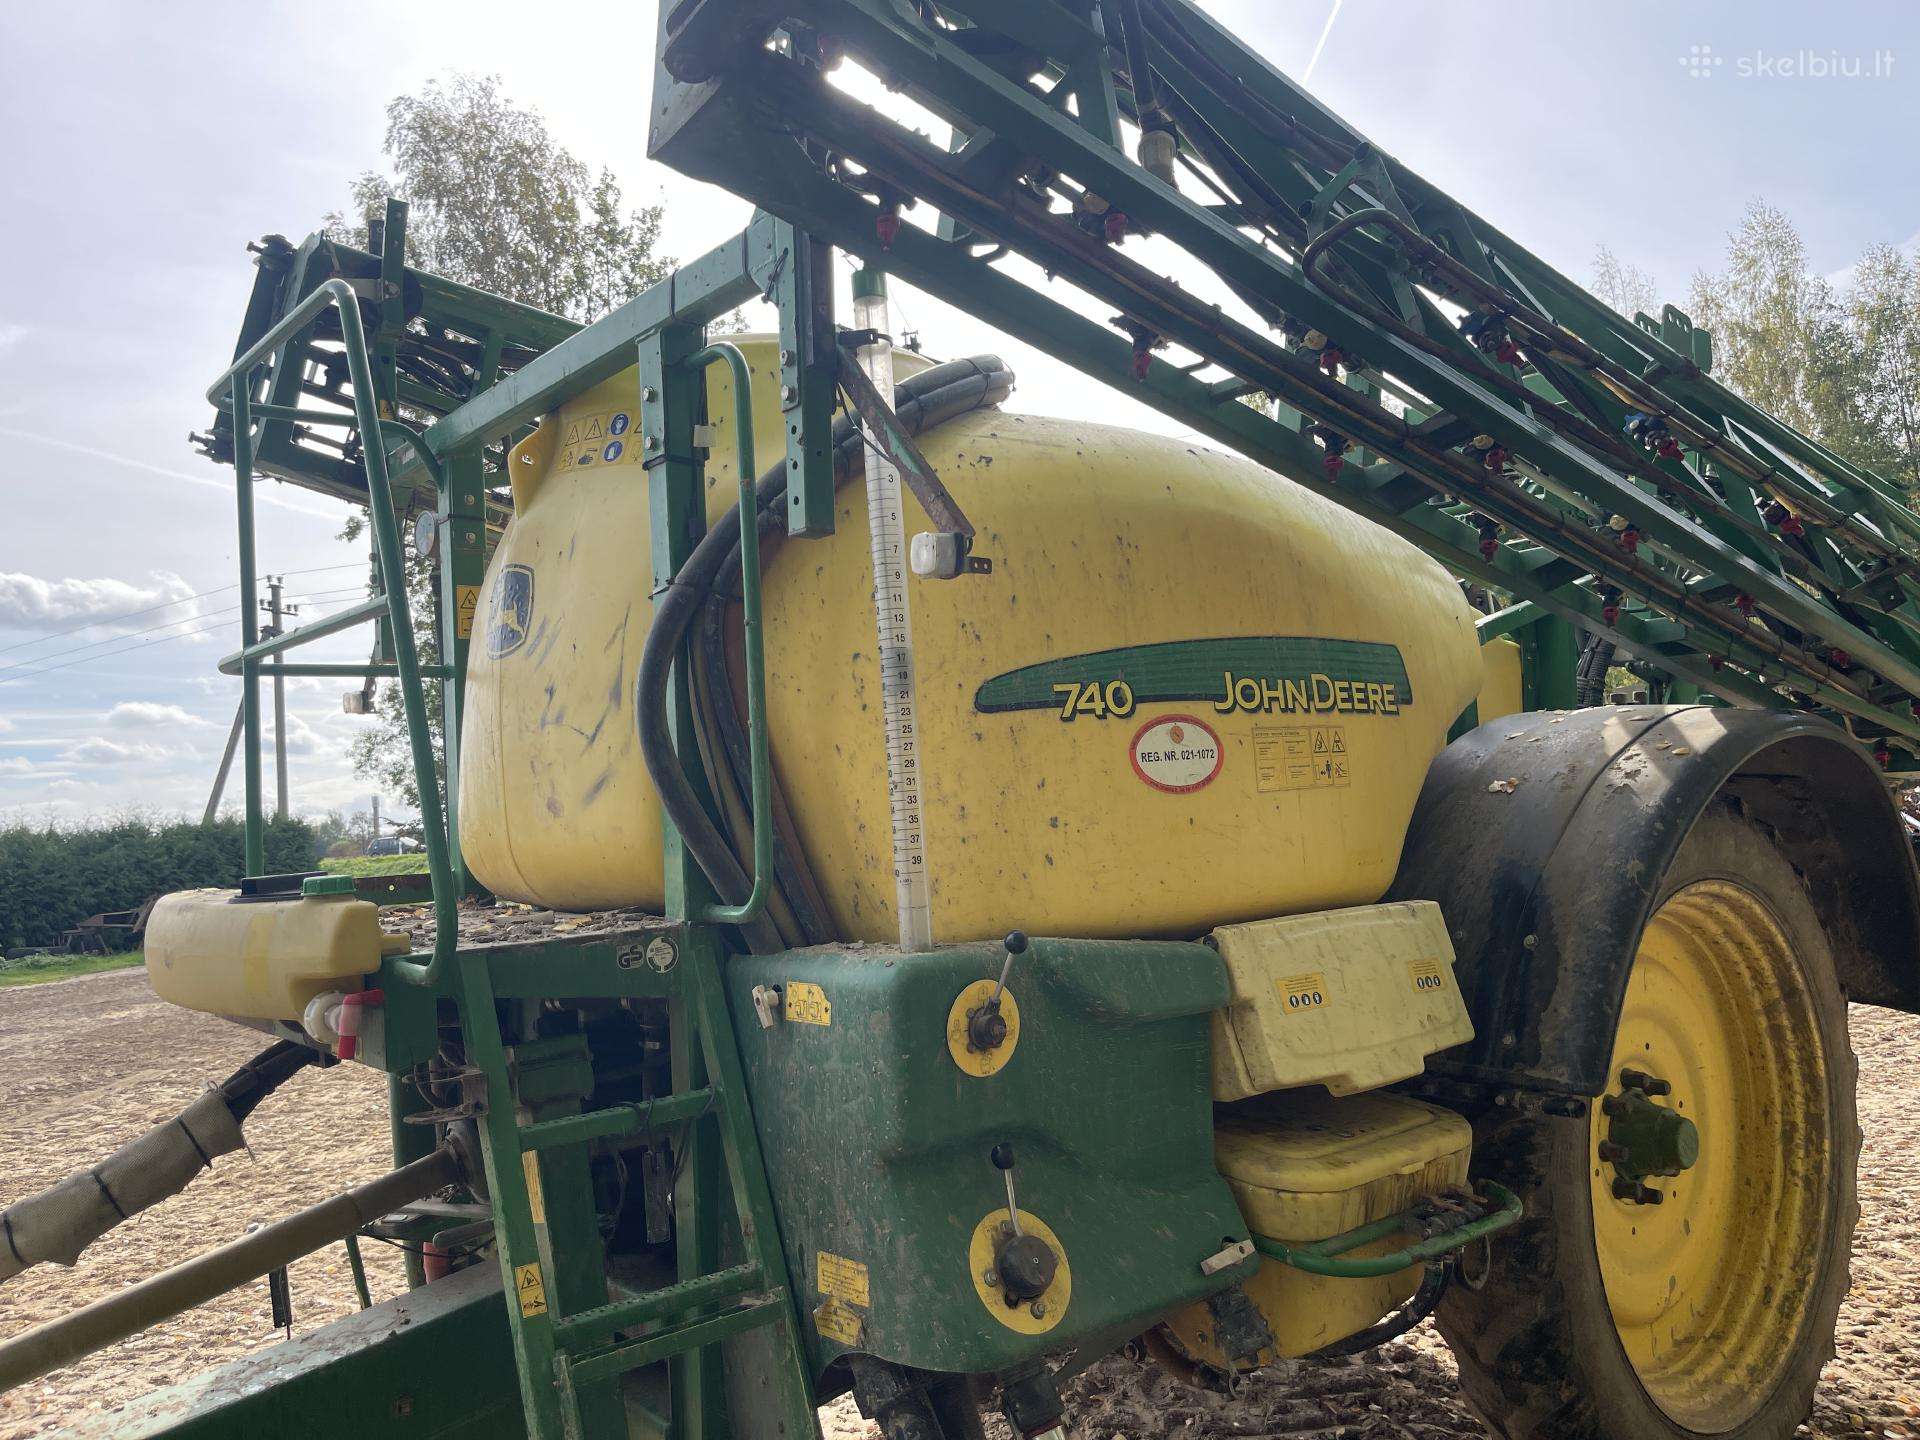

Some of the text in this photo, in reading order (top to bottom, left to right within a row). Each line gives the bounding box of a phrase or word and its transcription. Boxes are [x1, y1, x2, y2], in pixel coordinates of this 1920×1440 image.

[891, 513, 897, 521] 5
[893, 545, 898, 554] 7
[895, 571, 901, 580] 9
[893, 594, 902, 602] 11
[894, 613, 904, 622] 13
[895, 633, 906, 642] 15
[896, 653, 906, 661] 17
[899, 690, 909, 699] 21
[1052, 680, 1137, 722] 740
[900, 707, 911, 716] 23
[902, 724, 913, 733] 25
[903, 742, 914, 751] 27
[1141, 749, 1215, 763] REG. NR. 021-1072
[904, 759, 915, 768] 29
[906, 777, 916, 786] 31
[907, 795, 917, 804] 33
[908, 814, 919, 824] 35
[910, 834, 920, 844] 37
[911, 855, 922, 865] 39
